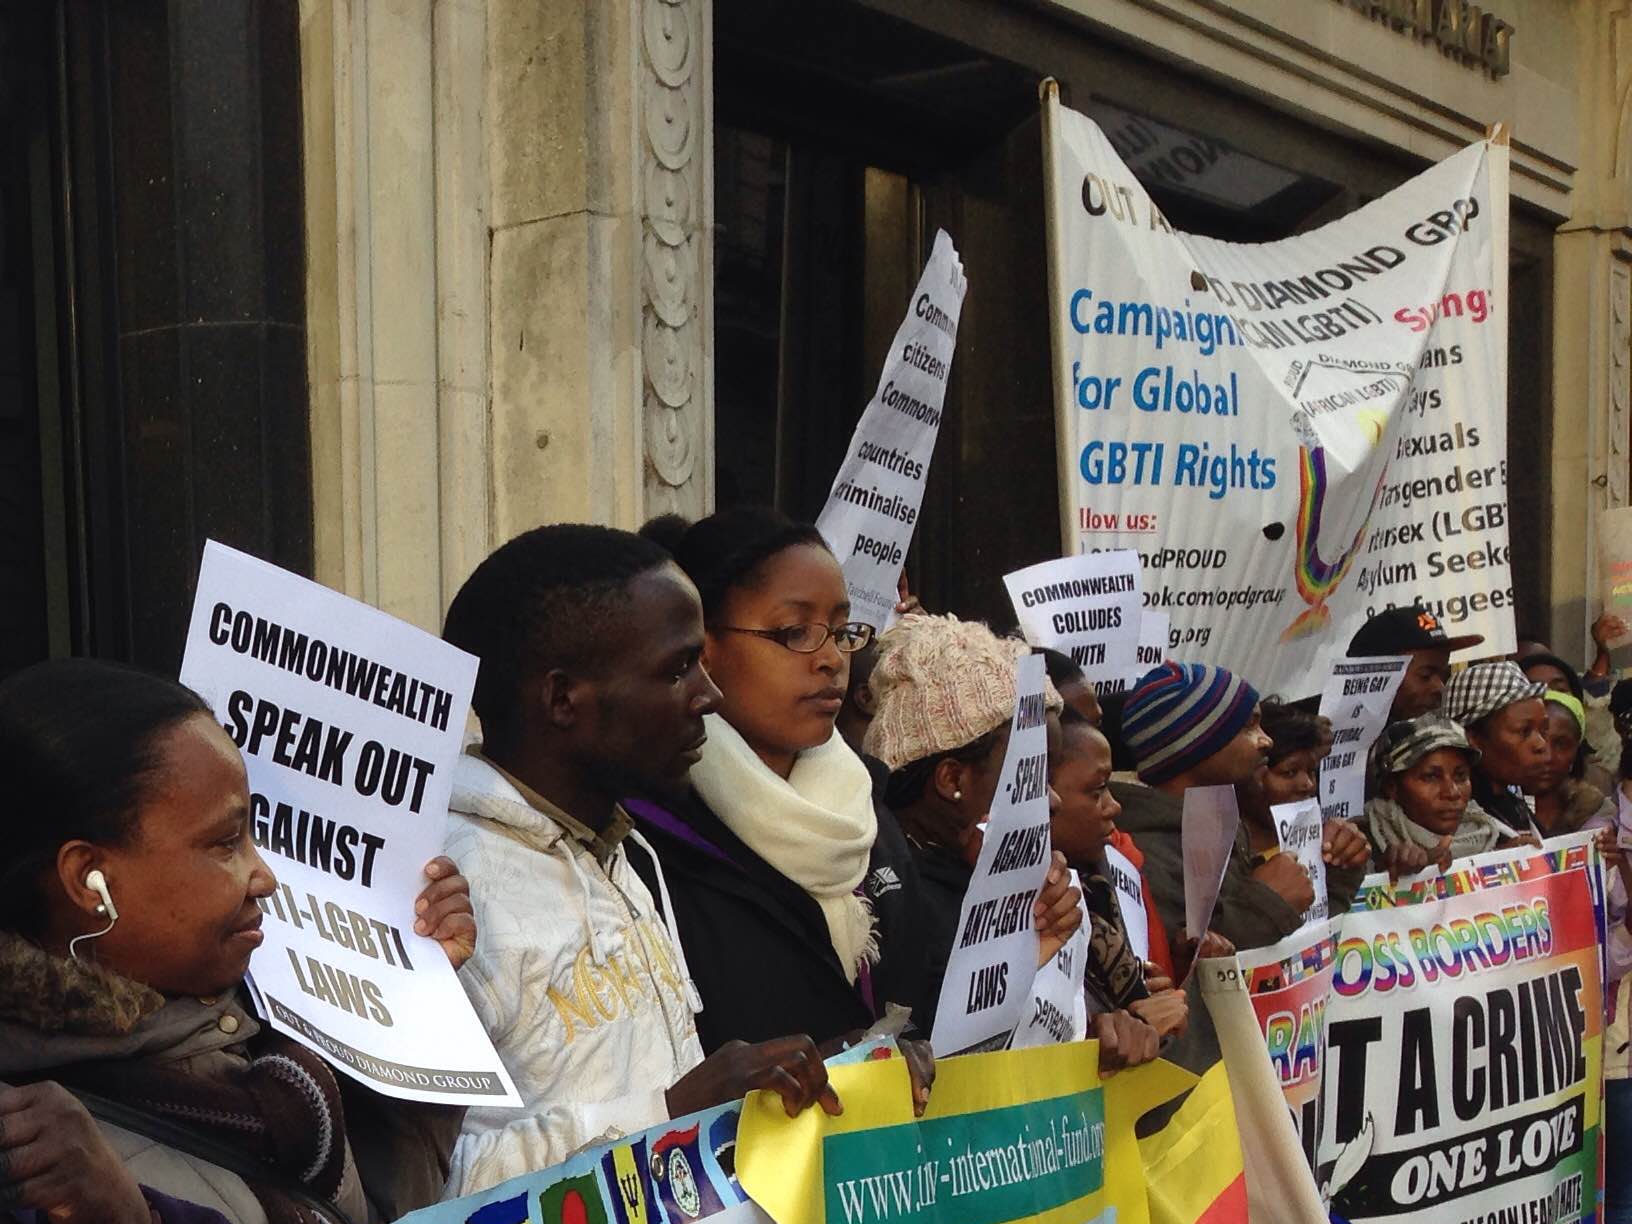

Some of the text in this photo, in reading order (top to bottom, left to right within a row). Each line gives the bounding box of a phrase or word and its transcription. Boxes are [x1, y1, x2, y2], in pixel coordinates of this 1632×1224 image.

[1082, 172, 1137, 225] OUT
[1232, 246, 1406, 311] DIAMOND
[1070, 288, 1244, 356] Campaign
[903, 342, 945, 381] citizens
[1132, 366, 1238, 416] Global
[858, 438, 923, 482] countries
[1174, 441, 1277, 500] Rights
[852, 531, 902, 567] people
[1127, 514, 1157, 530] us:
[1432, 502, 1507, 542] (LGB
[1021, 573, 1135, 608] COMMONWEALTH
[1052, 606, 1122, 635] COLLUDES
[209, 602, 453, 733] COMMONWEALTH
[1343, 675, 1391, 696] BEING GAY
[1352, 704, 1364, 719] IS
[223, 689, 435, 814] SPEAK OUT
[249, 792, 385, 888] GAINST
[1411, 896, 1552, 984] BORDERS
[286, 946, 394, 1028] LAWS
[966, 960, 1009, 1016] LAWS
[275, 1004, 300, 1031] OUT
[316, 1028, 356, 1063] PROUD
[356, 1056, 430, 1087] DIAMOND
[433, 1074, 492, 1090] GROUP
[1393, 1007, 1440, 1138] A
[1452, 966, 1587, 1122] CRIME
[1390, 1134, 1489, 1205] ONE
[1495, 1104, 1578, 1178] LOVE
